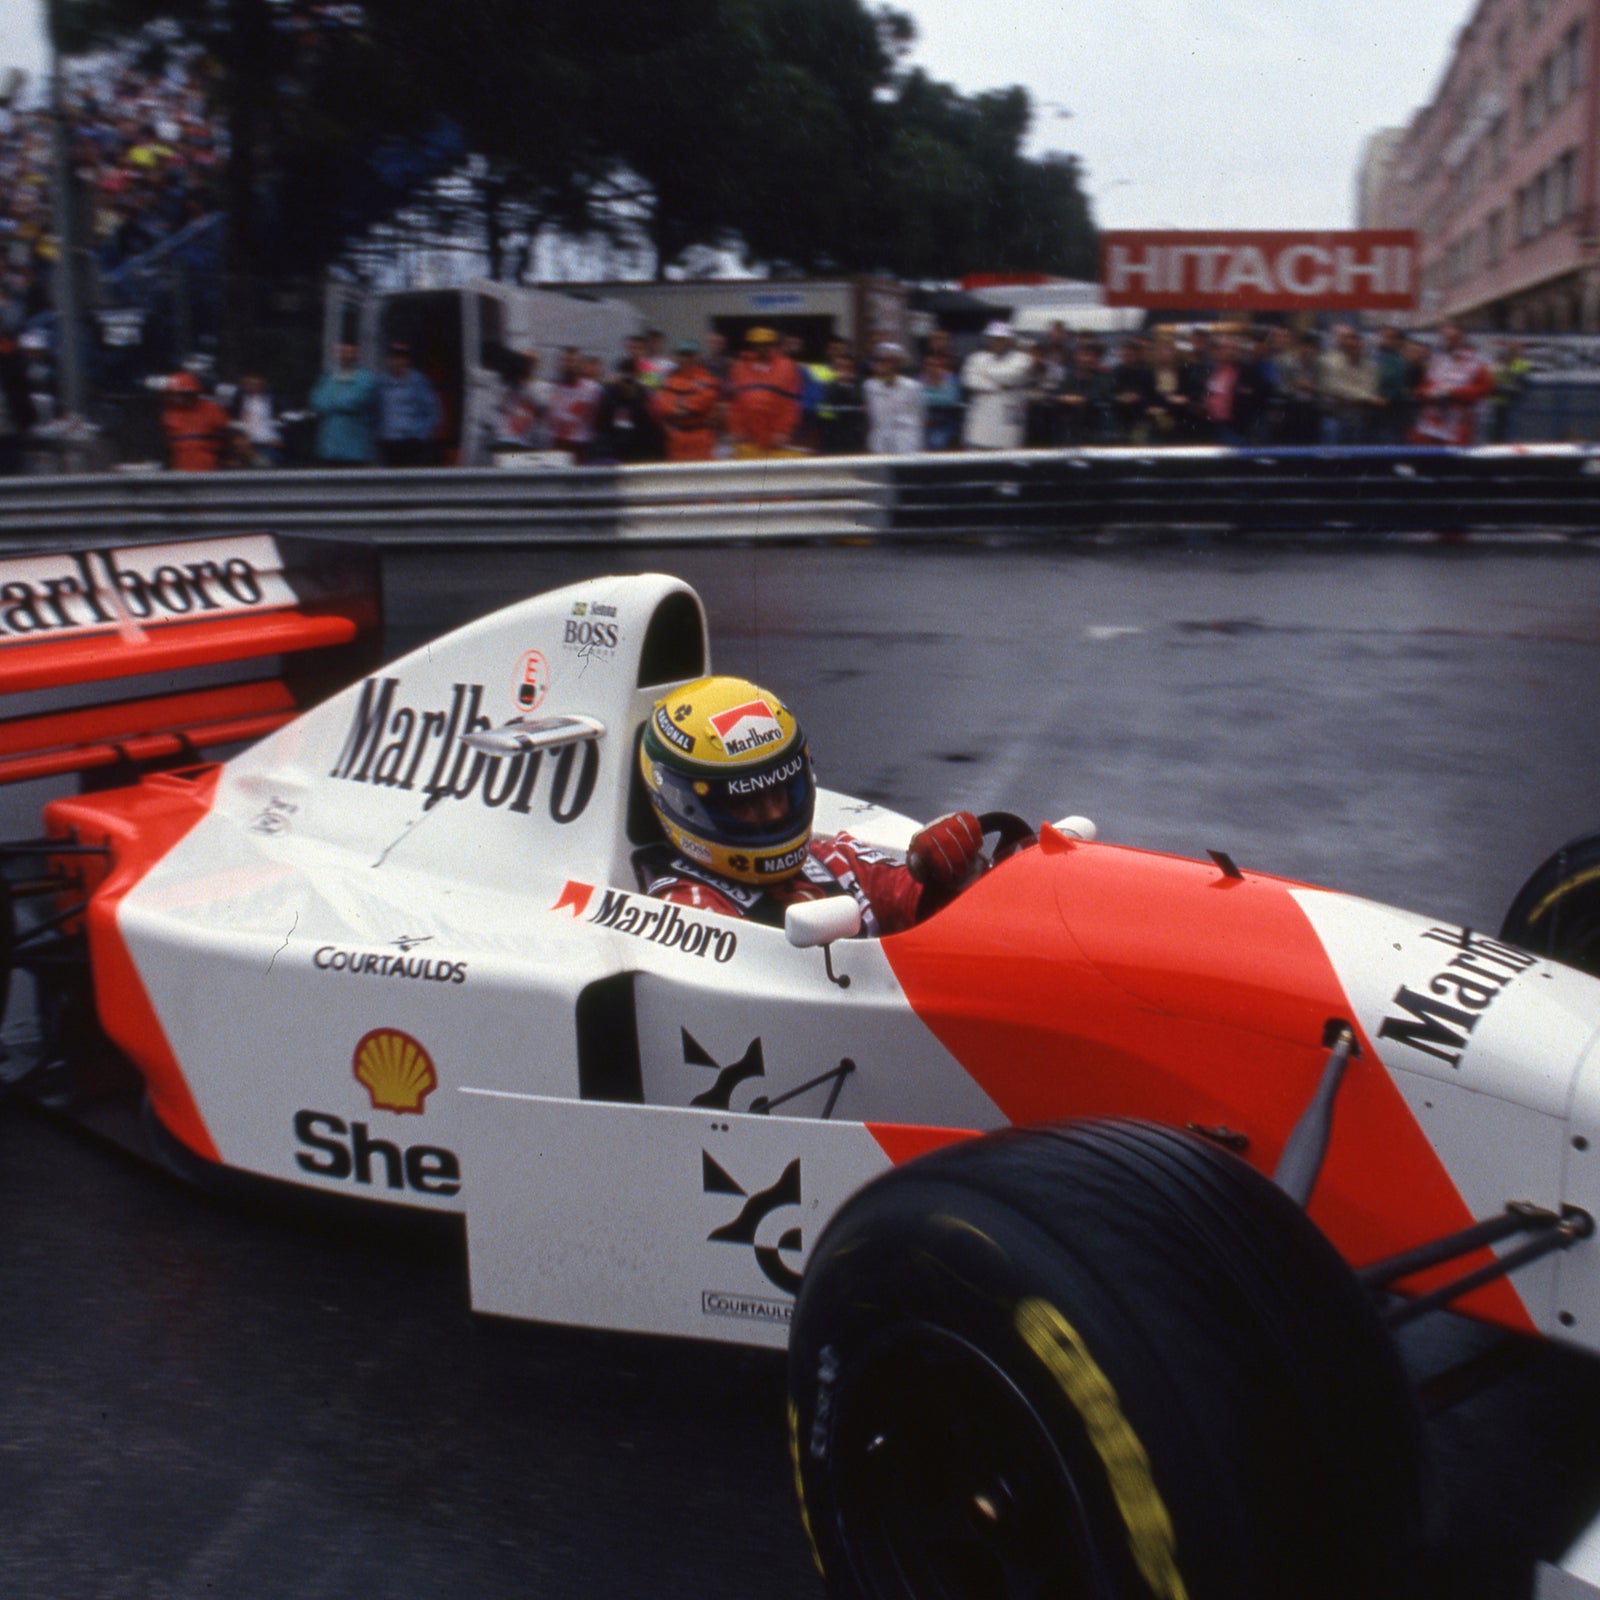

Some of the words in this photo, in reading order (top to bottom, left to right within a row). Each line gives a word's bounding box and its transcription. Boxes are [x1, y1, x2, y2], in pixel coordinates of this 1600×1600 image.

[1106, 244, 1411, 296] HITACHI
[0, 549, 262, 635] arlboro
[564, 620, 618, 648] BOSS
[657, 707, 690, 750] NACIONAL
[725, 727, 783, 756] Marlboro
[329, 677, 600, 824] Marlboro
[728, 755, 802, 795] KENWOOD
[764, 841, 809, 873] NACIO
[587, 889, 738, 964] Marlboro
[313, 945, 468, 985] COURTAULDS
[293, 1109, 462, 1197] She
